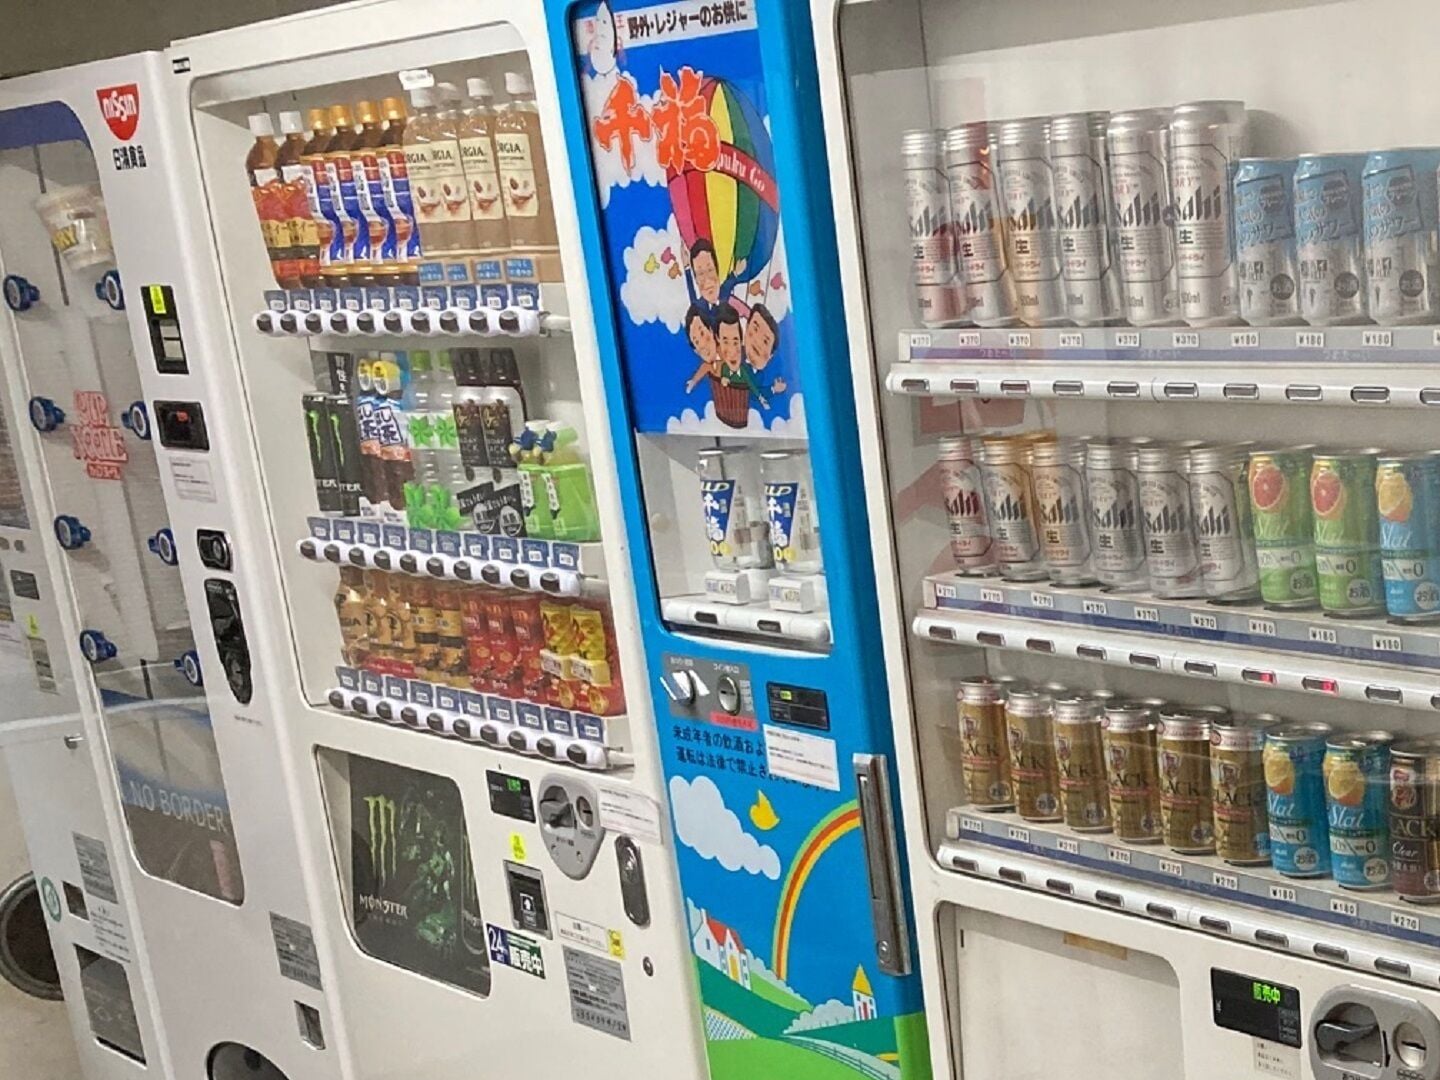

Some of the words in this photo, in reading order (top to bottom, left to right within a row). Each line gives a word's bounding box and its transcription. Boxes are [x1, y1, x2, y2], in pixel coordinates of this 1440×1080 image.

[627, 1, 748, 39] 野外・レジャーのお供に
[1015, 239, 1030, 254] 生
[1062, 237, 1075, 253] 生
[1121, 235, 1135, 251] 生
[1179, 229, 1194, 244] 生
[1234, 335, 1256, 345] ¥180
[1299, 335, 1321, 345] ¥180
[1365, 334, 1389, 344] ¥180
[1194, 616, 1214, 627] ¥270
[1252, 623, 1272, 633] ¥180
[1376, 639, 1399, 649] ¥180
[129, 779, 154, 811] NO
[158, 789, 228, 834] BORDER
[1330, 804, 1364, 828] Slat
[359, 893, 408, 920] MONSTER
[1272, 889, 1293, 900] ¥180
[1394, 916, 1417, 929] ¥270
[489, 928, 505, 954] 24
[1252, 981, 1281, 1004] 販売中
